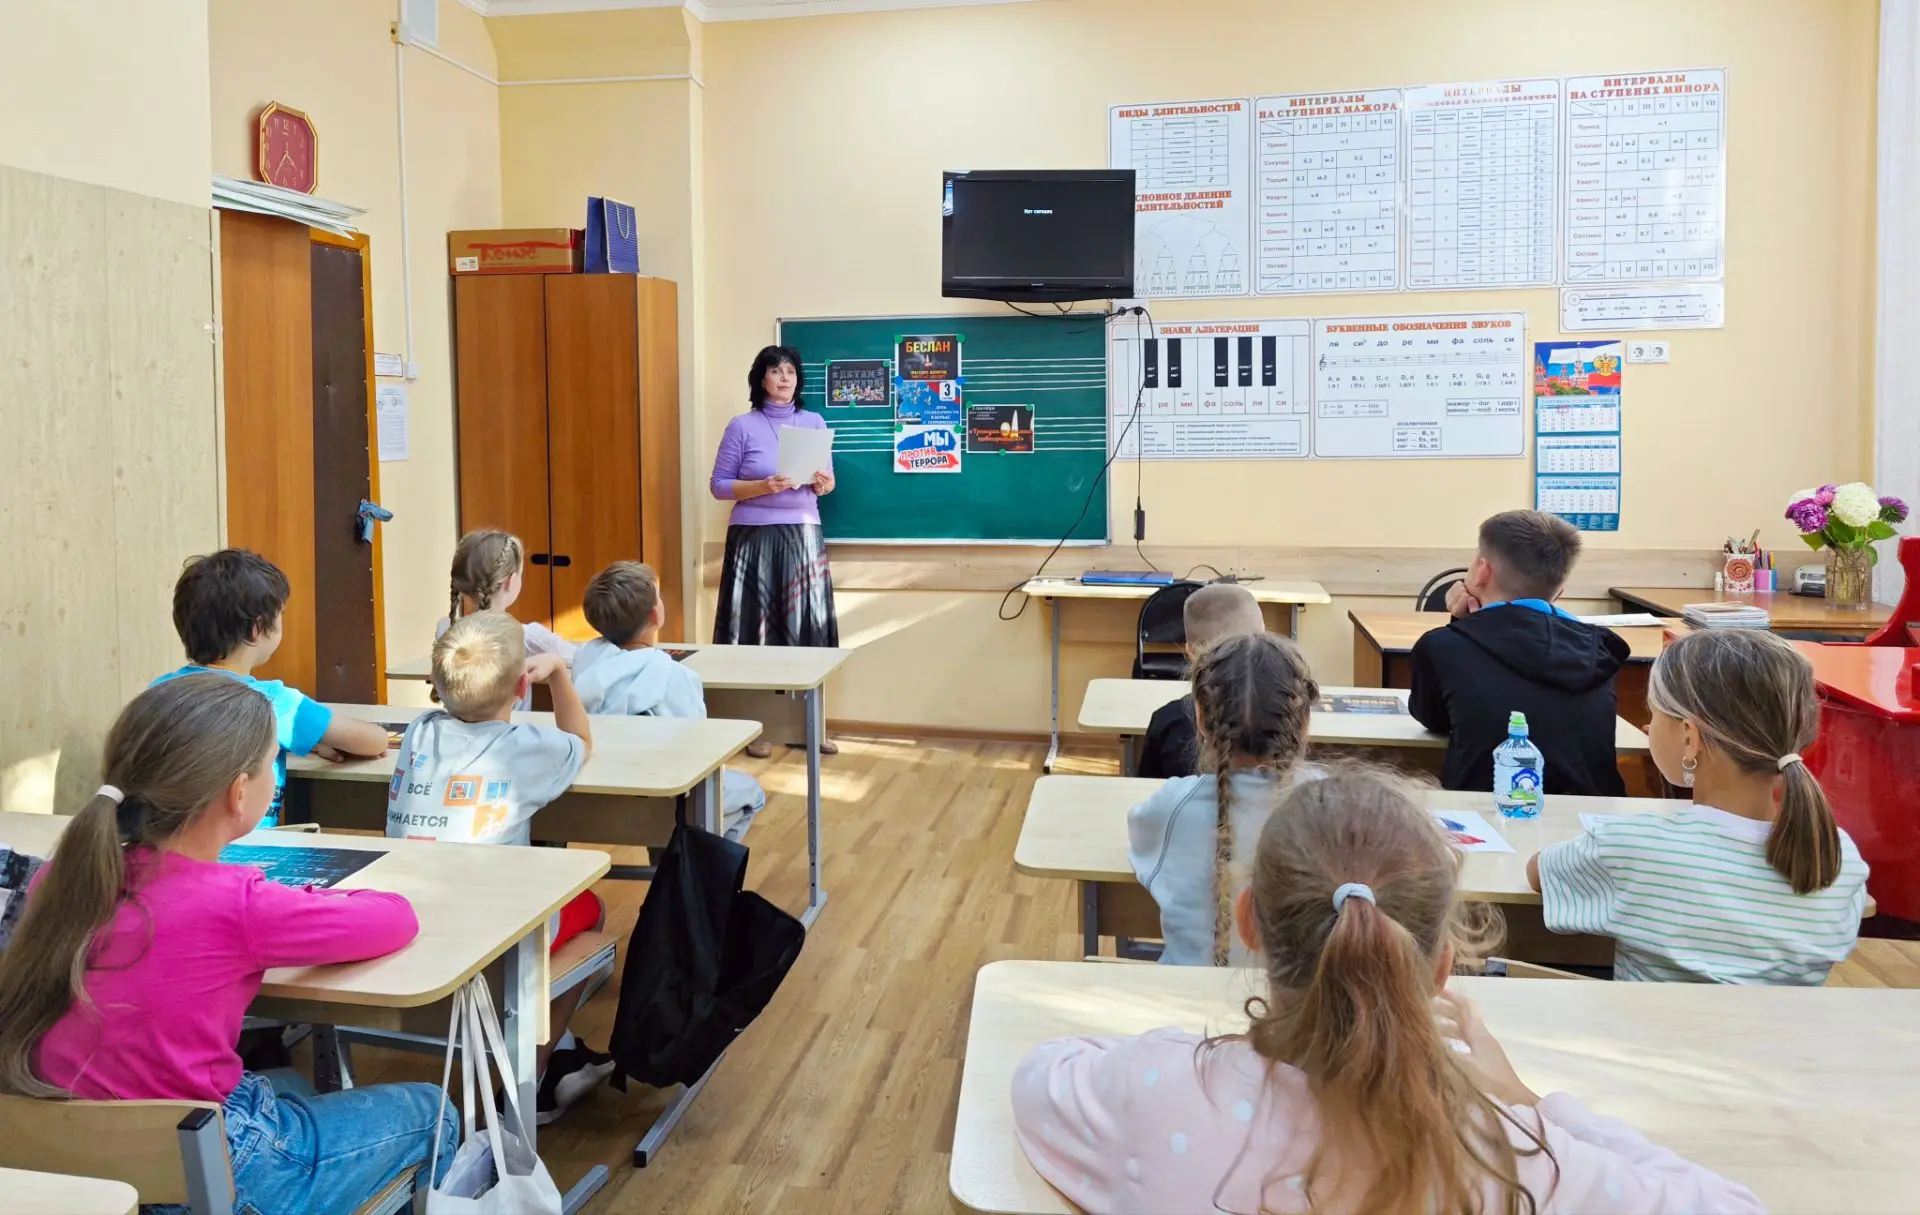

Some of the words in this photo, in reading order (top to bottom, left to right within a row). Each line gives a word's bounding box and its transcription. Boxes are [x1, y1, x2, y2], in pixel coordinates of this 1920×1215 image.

[1603, 74, 1686, 87] ИНТЕРВАЛЫ
[1570, 91, 1587, 100] НА
[1590, 86, 1660, 98] СТУПЕНЯХ
[1663, 84, 1720, 94] МИНОРА
[1290, 95, 1365, 106] ИНТЕРВАЛЫ
[1119, 108, 1148, 118] ВИДЫ
[1152, 102, 1242, 116] ДЛИТЕЛЬНОСТЕЙ
[1260, 110, 1274, 119] НА
[1277, 106, 1340, 117] СТУПЕНЯХ
[1344, 102, 1398, 113] МАЖОРА
[283, 119, 289, 129] 12
[1136, 192, 1182, 202] СНОВНОЕ
[1184, 190, 1232, 200] ДЕЛЕНИЕ
[1136, 200, 1224, 212] ДЛИТЕЛЬНОСТЕЙ
[1160, 326, 1192, 334] ЗНАКИ
[1195, 324, 1260, 334] АЛЬТЕРАЦИИ
[1327, 324, 1388, 333] БУКВЕННЫЕ
[1392, 322, 1467, 332] ОБОЗНАЧЕНИЯ
[1471, 320, 1511, 329] ЗВУКОВ
[906, 341, 950, 353] БЕСЛАН
[944, 384, 950, 396] 3
[1204, 400, 1216, 408] фа
[924, 432, 948, 446] МЫ
[902, 447, 937, 459] ПРОТИВ
[910, 456, 947, 468] ТЕРРОРА
[408, 782, 432, 795] ВСЁ
